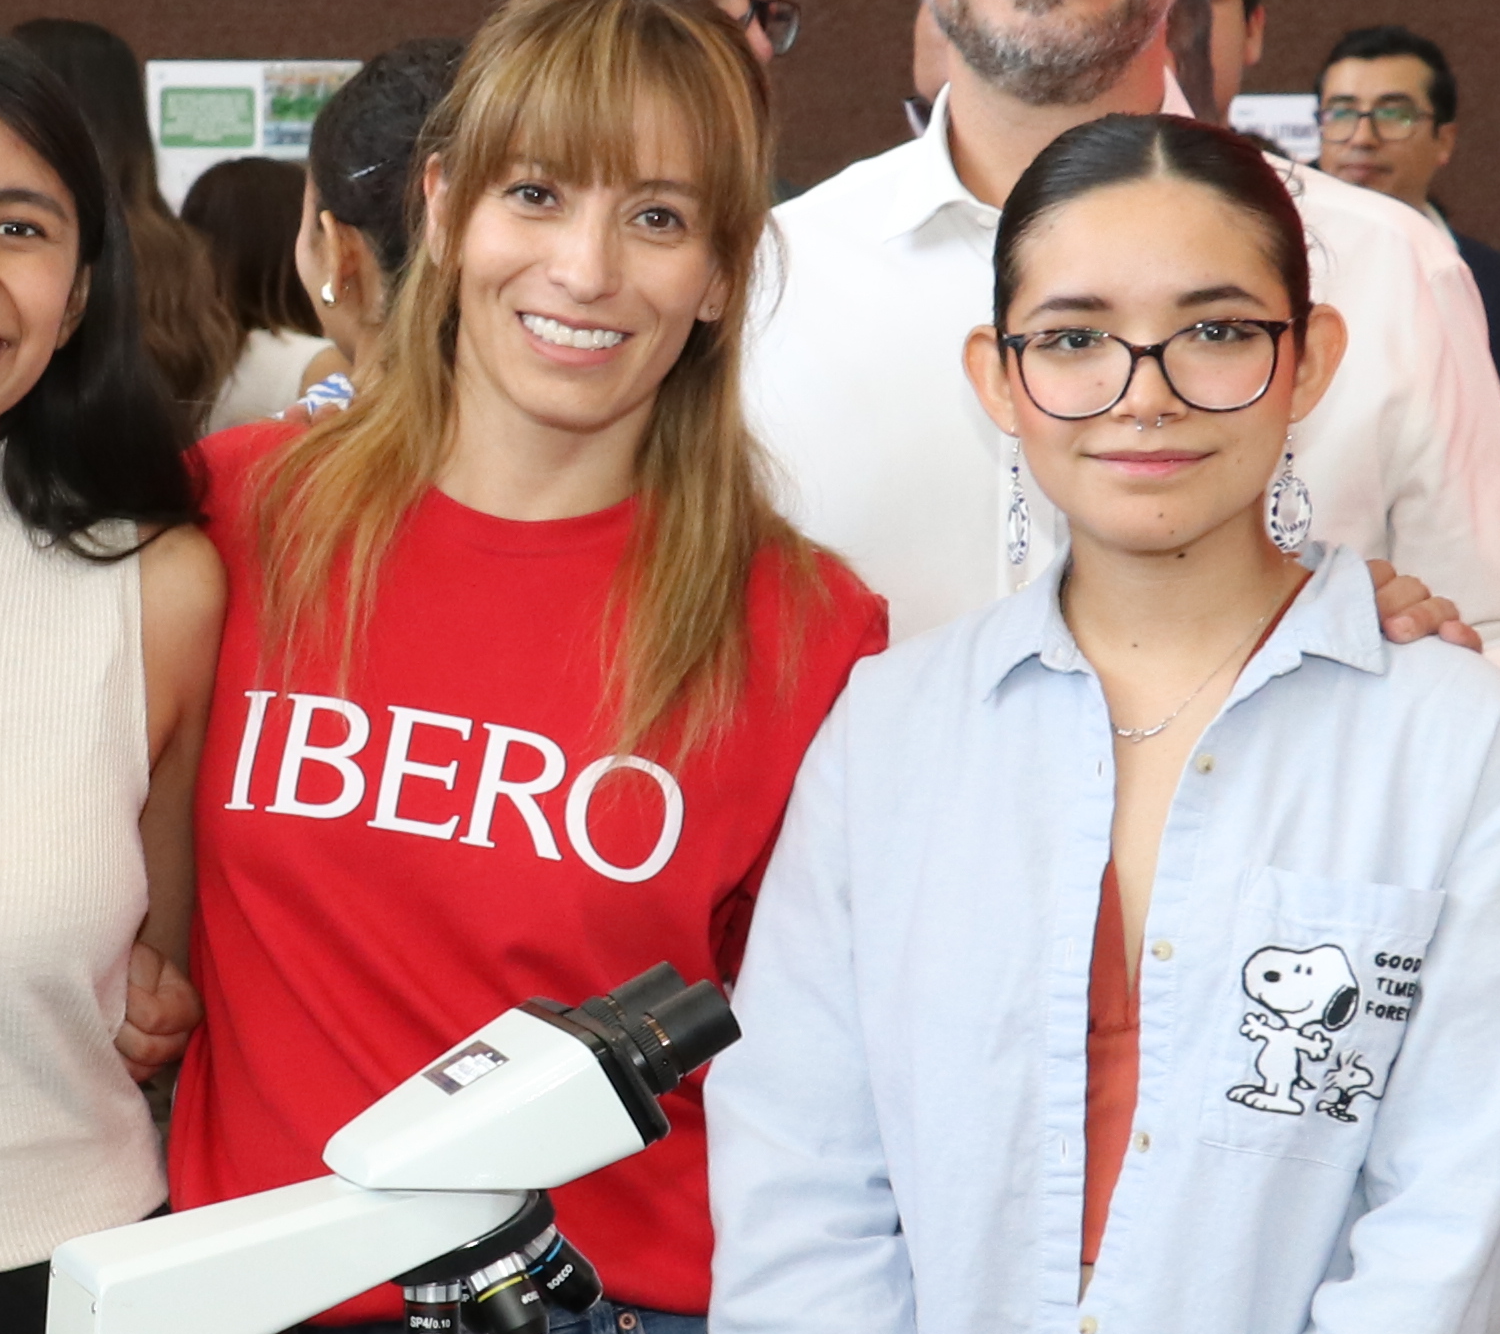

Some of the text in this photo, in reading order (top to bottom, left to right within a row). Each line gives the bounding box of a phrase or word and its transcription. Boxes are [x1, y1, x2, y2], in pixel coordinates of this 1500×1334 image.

[224, 689, 684, 884] IBERO
[1375, 951, 1423, 973] GOOD
[409, 1315, 451, 1330] SP4/0.10
